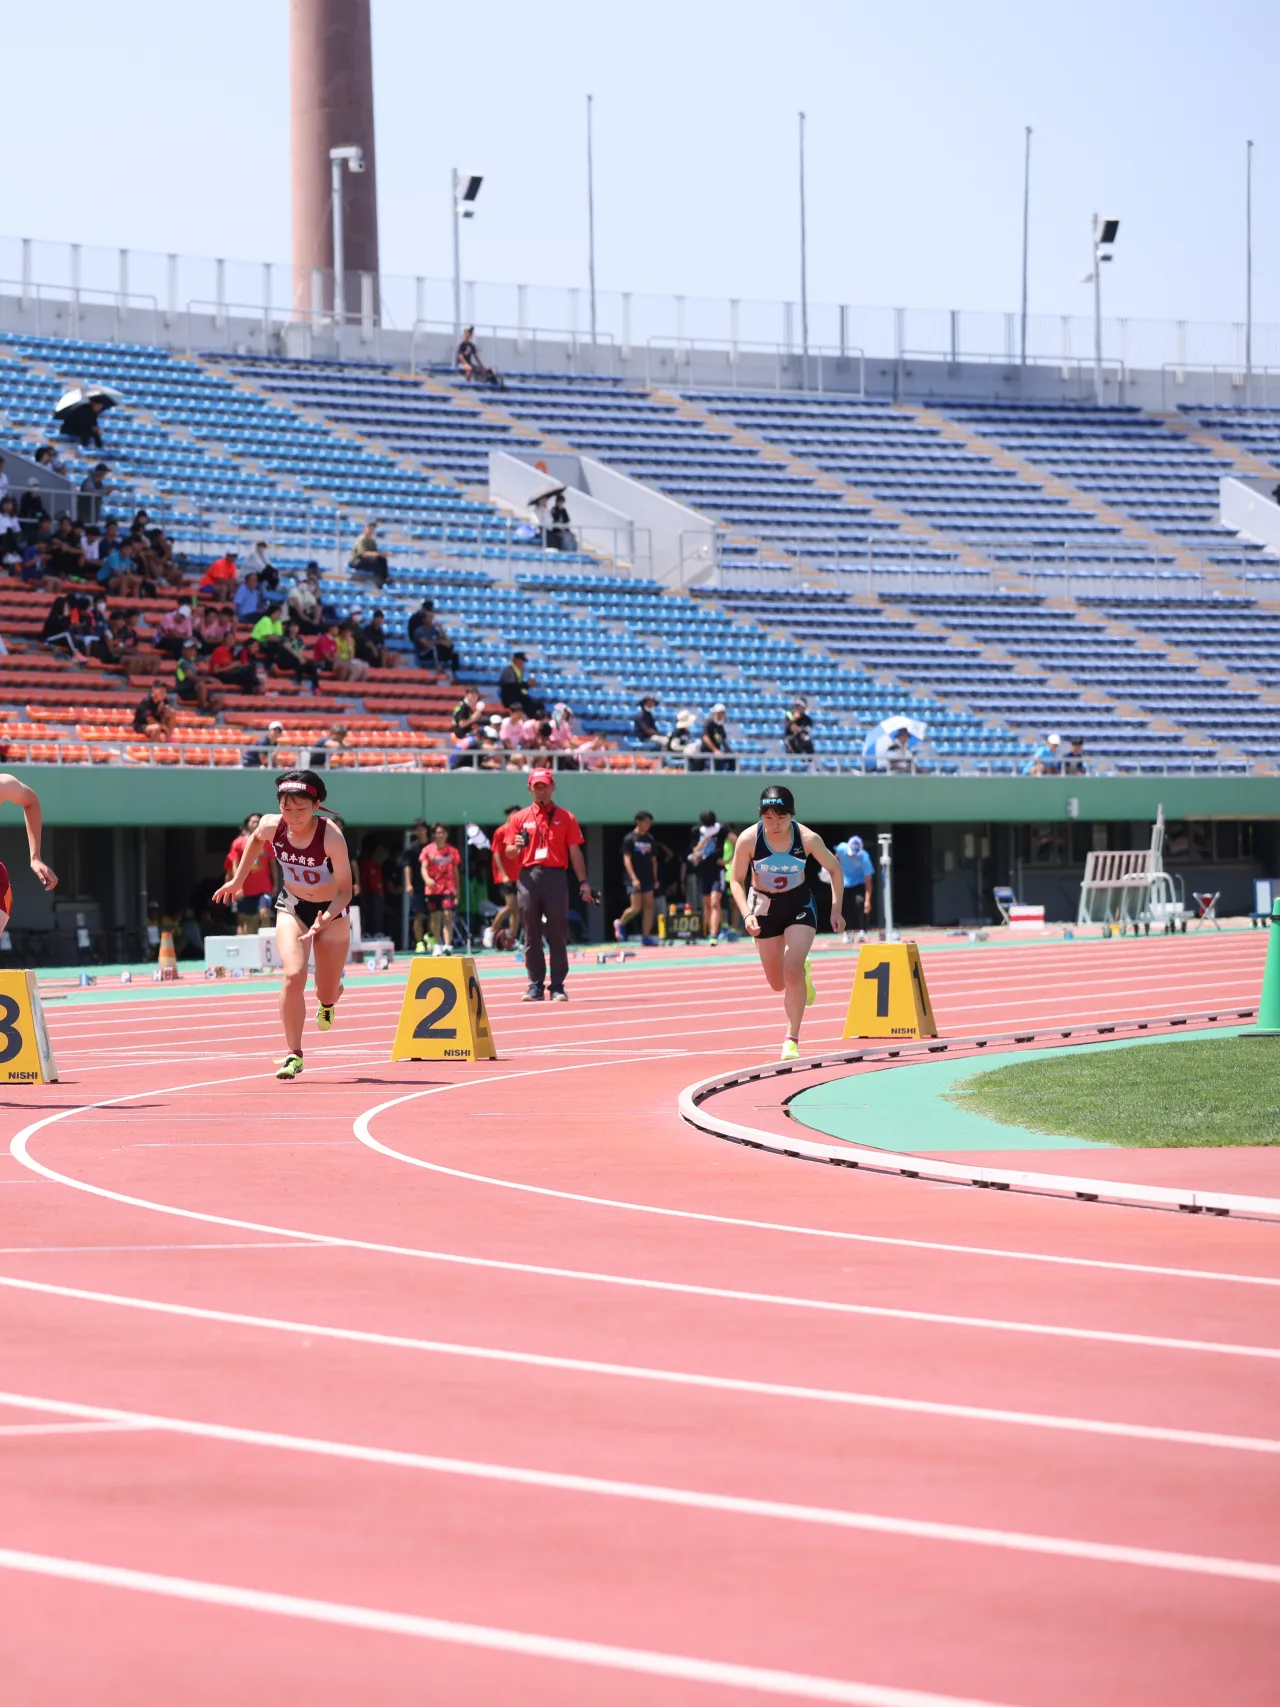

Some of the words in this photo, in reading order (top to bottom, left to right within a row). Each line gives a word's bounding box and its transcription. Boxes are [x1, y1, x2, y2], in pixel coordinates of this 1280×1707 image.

[288, 867, 320, 885] 10
[412, 977, 458, 1039] 2
[468, 976, 488, 1038] 2
[864, 962, 890, 1017] 1
[912, 961, 927, 1016] 1
